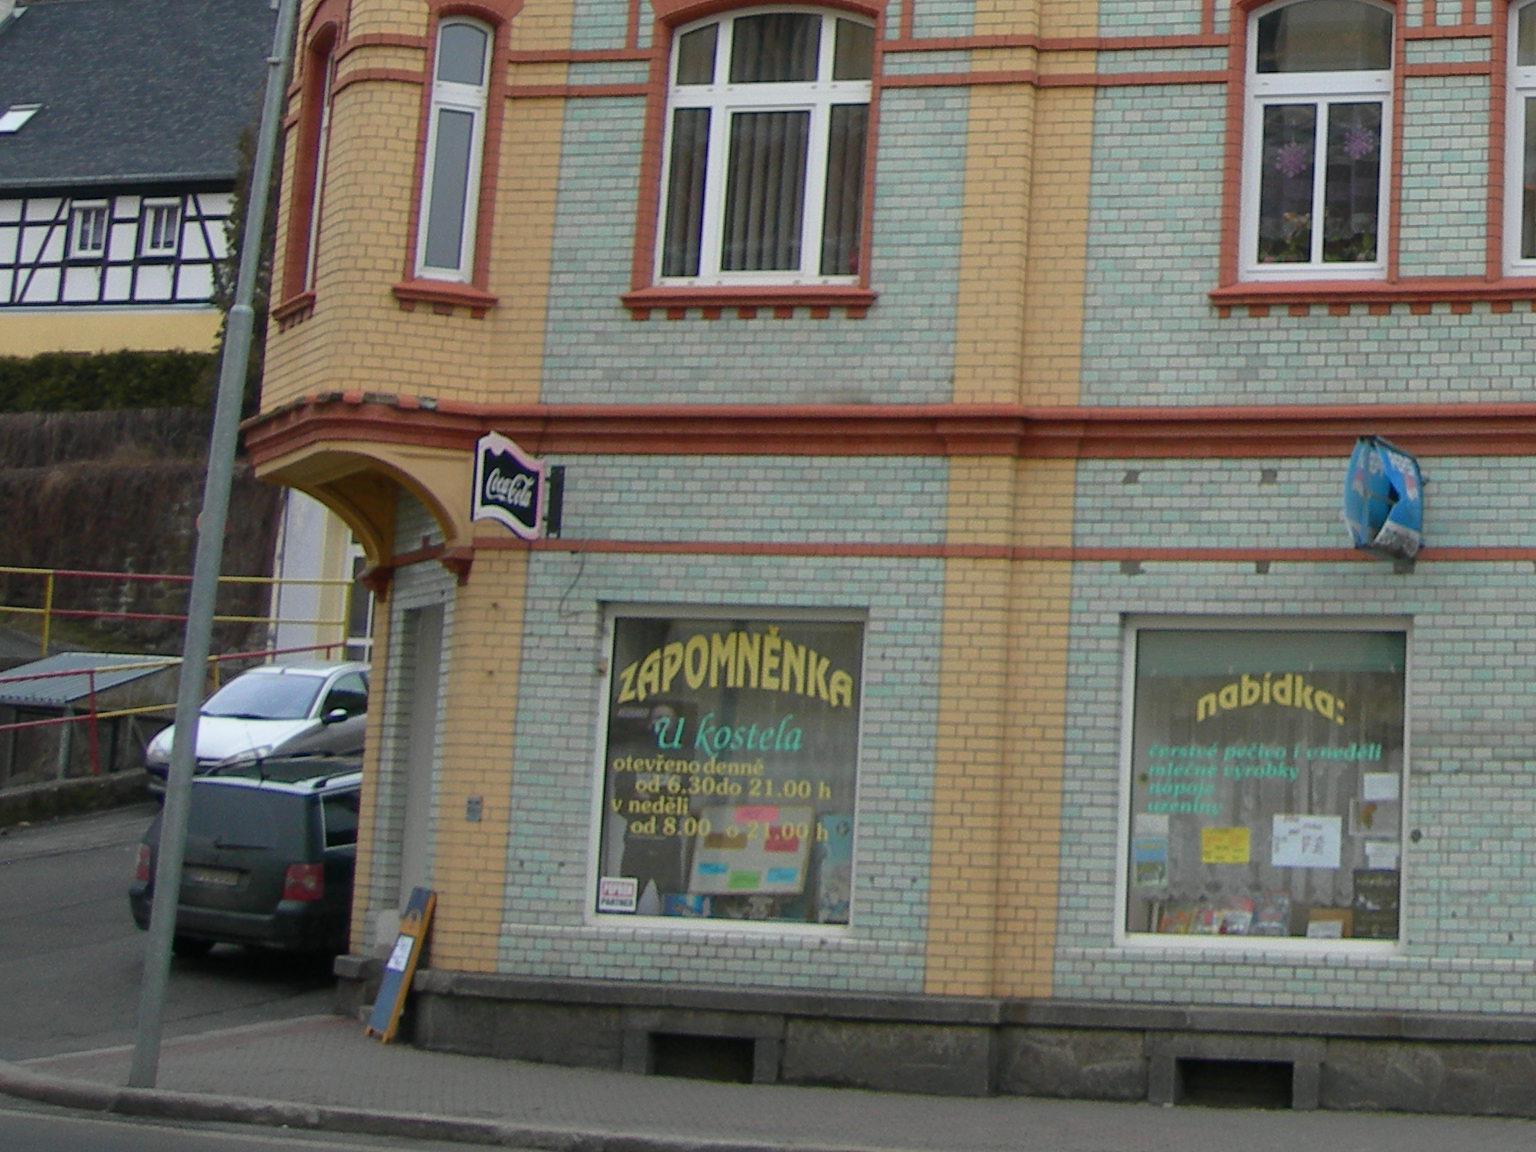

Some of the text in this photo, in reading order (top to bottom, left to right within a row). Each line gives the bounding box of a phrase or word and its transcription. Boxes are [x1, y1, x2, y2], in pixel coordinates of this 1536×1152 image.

[617, 625, 853, 708] ZAPOMNĚNKA
[653, 712, 805, 757] U kostela
[613, 755, 764, 776] otevřeno denně
[635, 774, 660, 793] od
[667, 776, 715, 796] 6.30
[750, 778, 812, 798] 21.00
[818, 781, 832, 799] h
[611, 796, 690, 816] v neděli
[630, 816, 657, 835] od
[662, 816, 711, 838] 8.00
[816, 822, 829, 842] h
